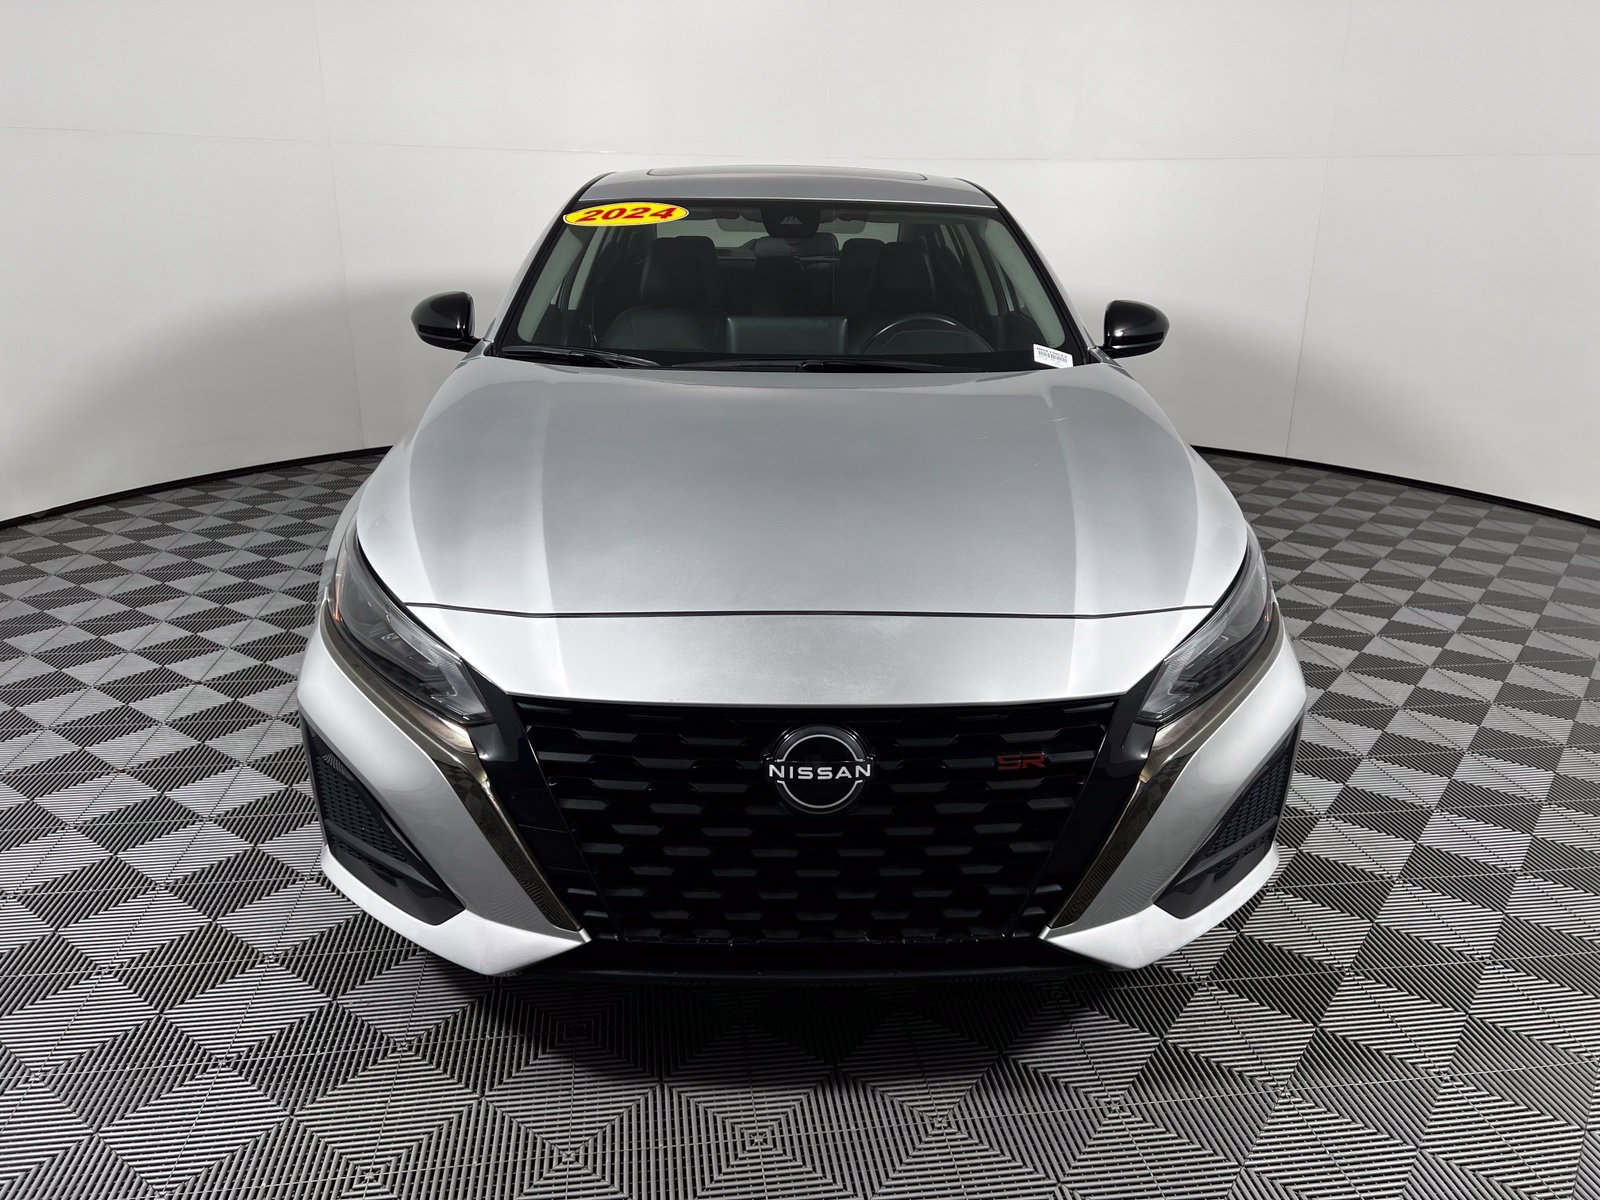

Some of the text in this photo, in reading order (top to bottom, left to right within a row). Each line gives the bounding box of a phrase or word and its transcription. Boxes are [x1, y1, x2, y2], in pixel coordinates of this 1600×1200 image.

[575, 207, 677, 222] 2024
[998, 753, 1046, 770] SR
[769, 764, 871, 780] NISSAN
